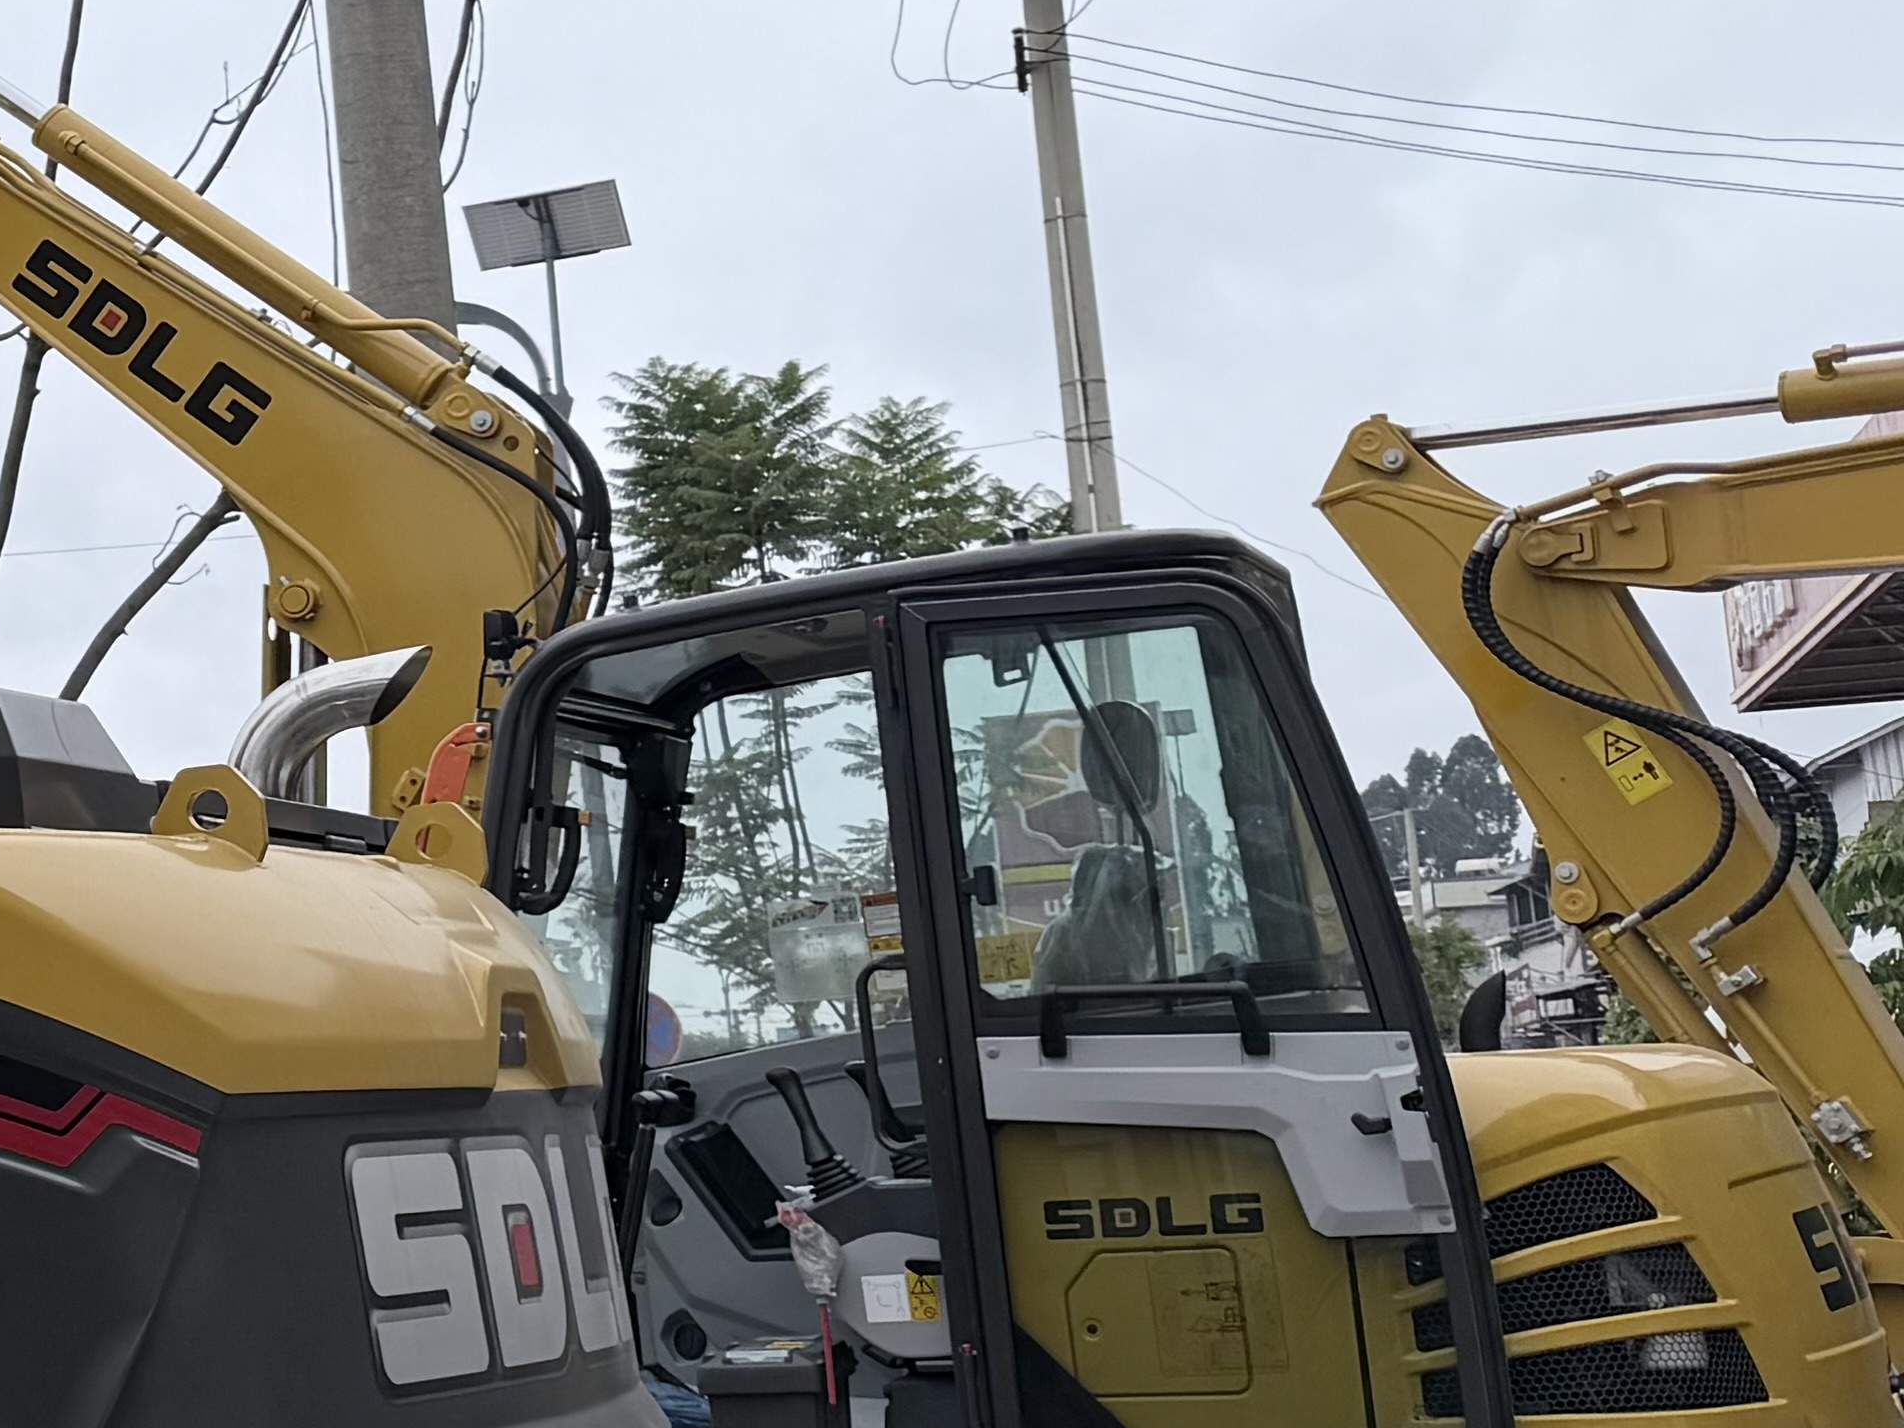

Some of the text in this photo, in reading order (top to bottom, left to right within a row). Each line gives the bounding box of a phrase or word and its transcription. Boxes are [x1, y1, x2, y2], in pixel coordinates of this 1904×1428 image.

[11, 239, 272, 446] SDLG
[345, 1135, 632, 1386] SDL
[1043, 1192, 1265, 1241] SDLG
